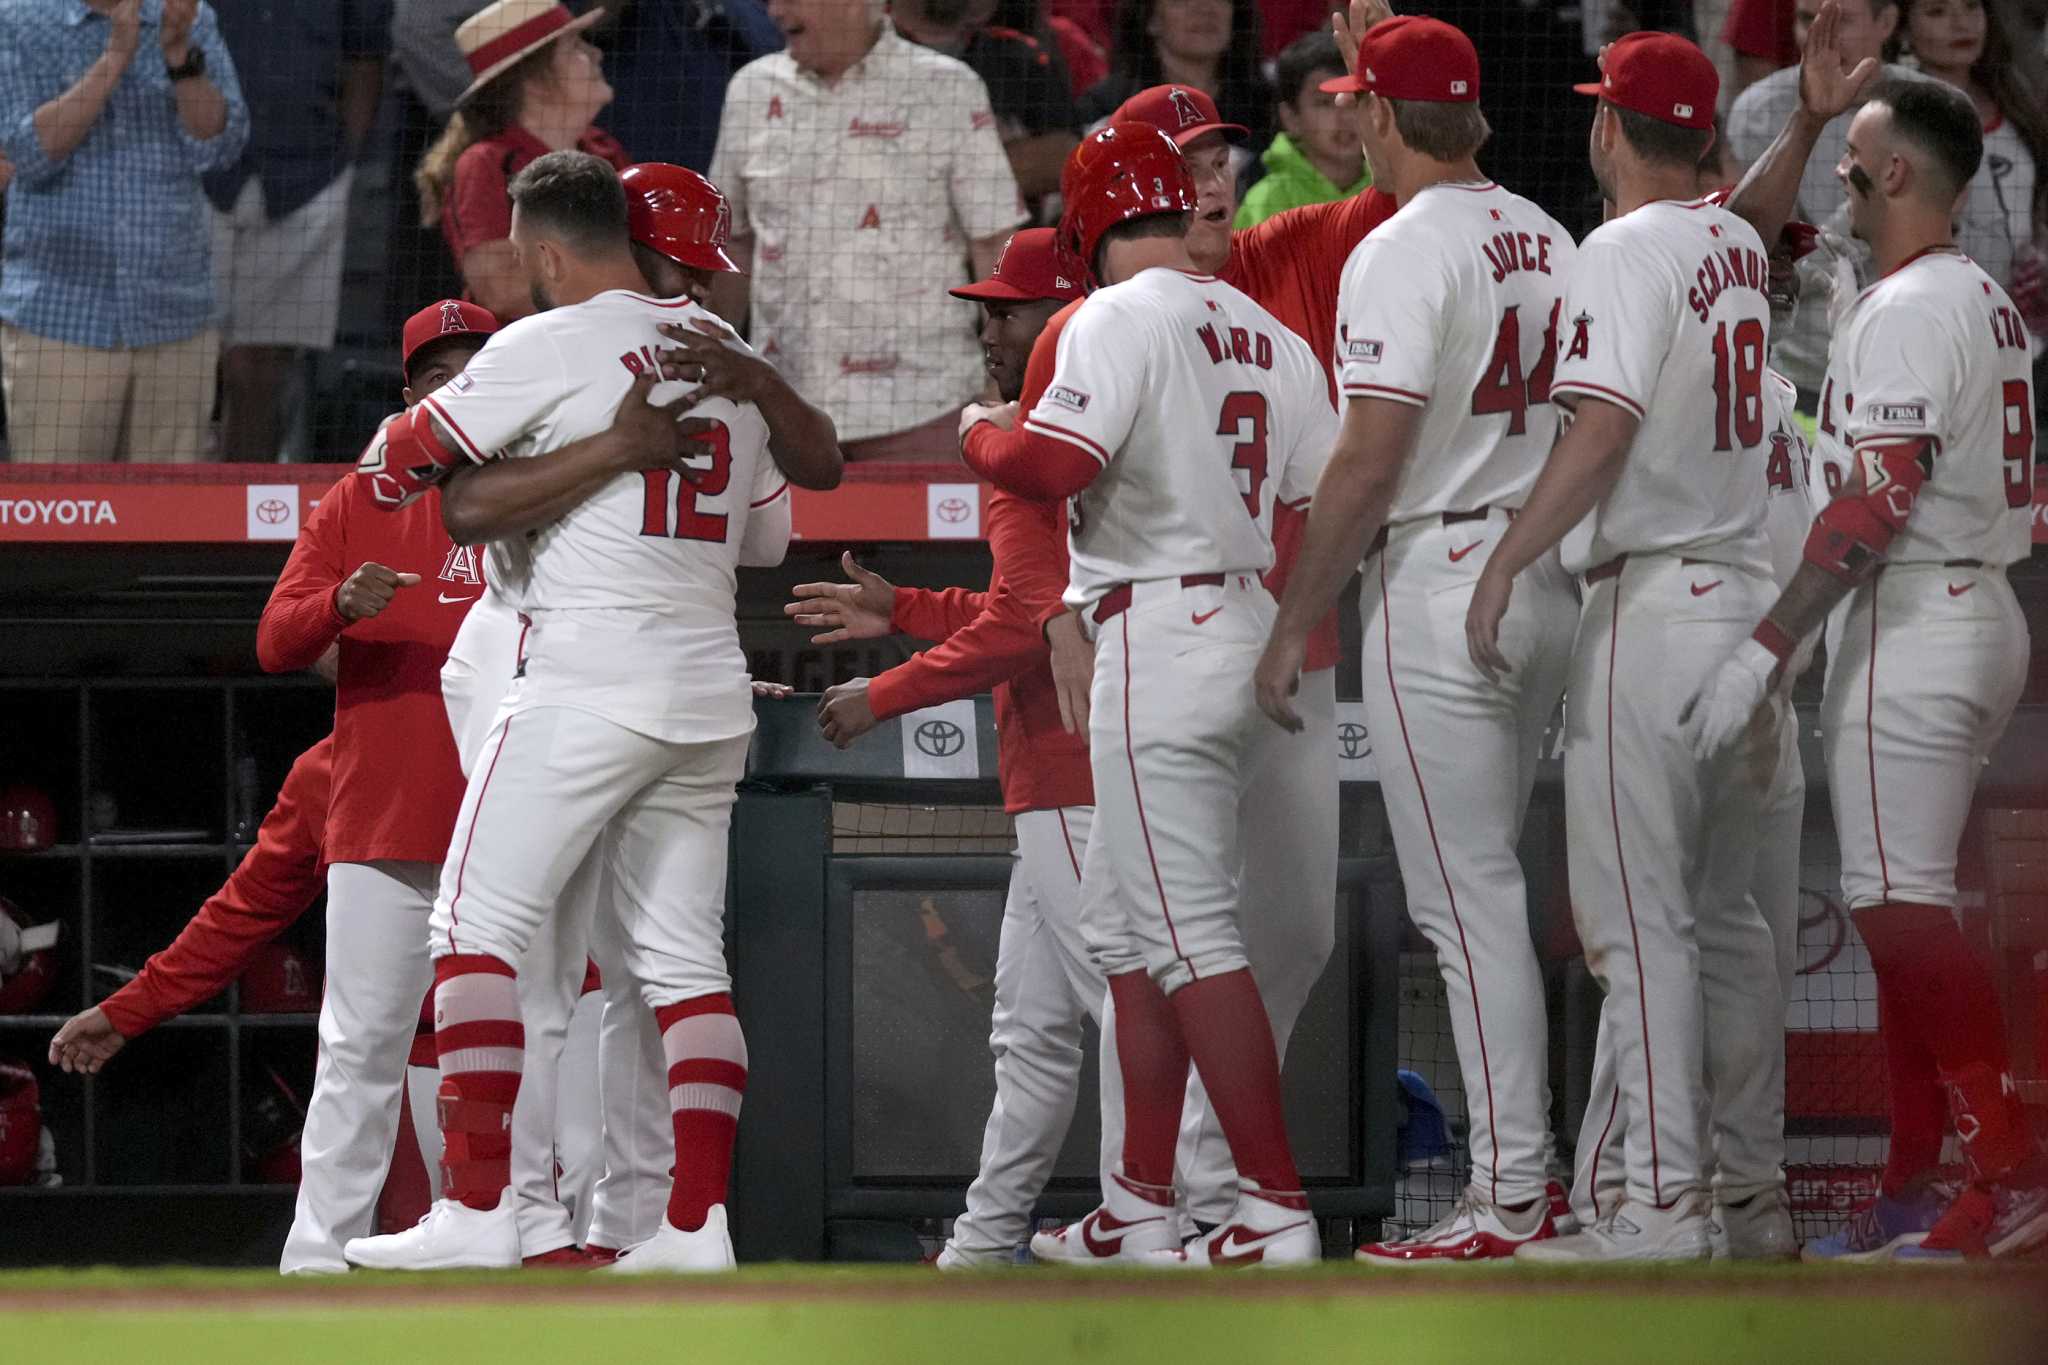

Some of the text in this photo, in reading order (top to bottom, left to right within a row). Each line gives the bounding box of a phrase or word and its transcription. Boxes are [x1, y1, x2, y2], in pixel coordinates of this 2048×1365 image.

[1169, 87, 1206, 127] A
[1481, 231, 1552, 284] JOYCE
[440, 300, 469, 334] A
[1565, 307, 1594, 362] A
[1712, 317, 1765, 452] 18
[1216, 391, 1269, 520] 3
[2002, 378, 2034, 509] 9
[639, 417, 734, 544] 12
[0, 499, 117, 525] TOYOTA
[437, 542, 482, 585] A
